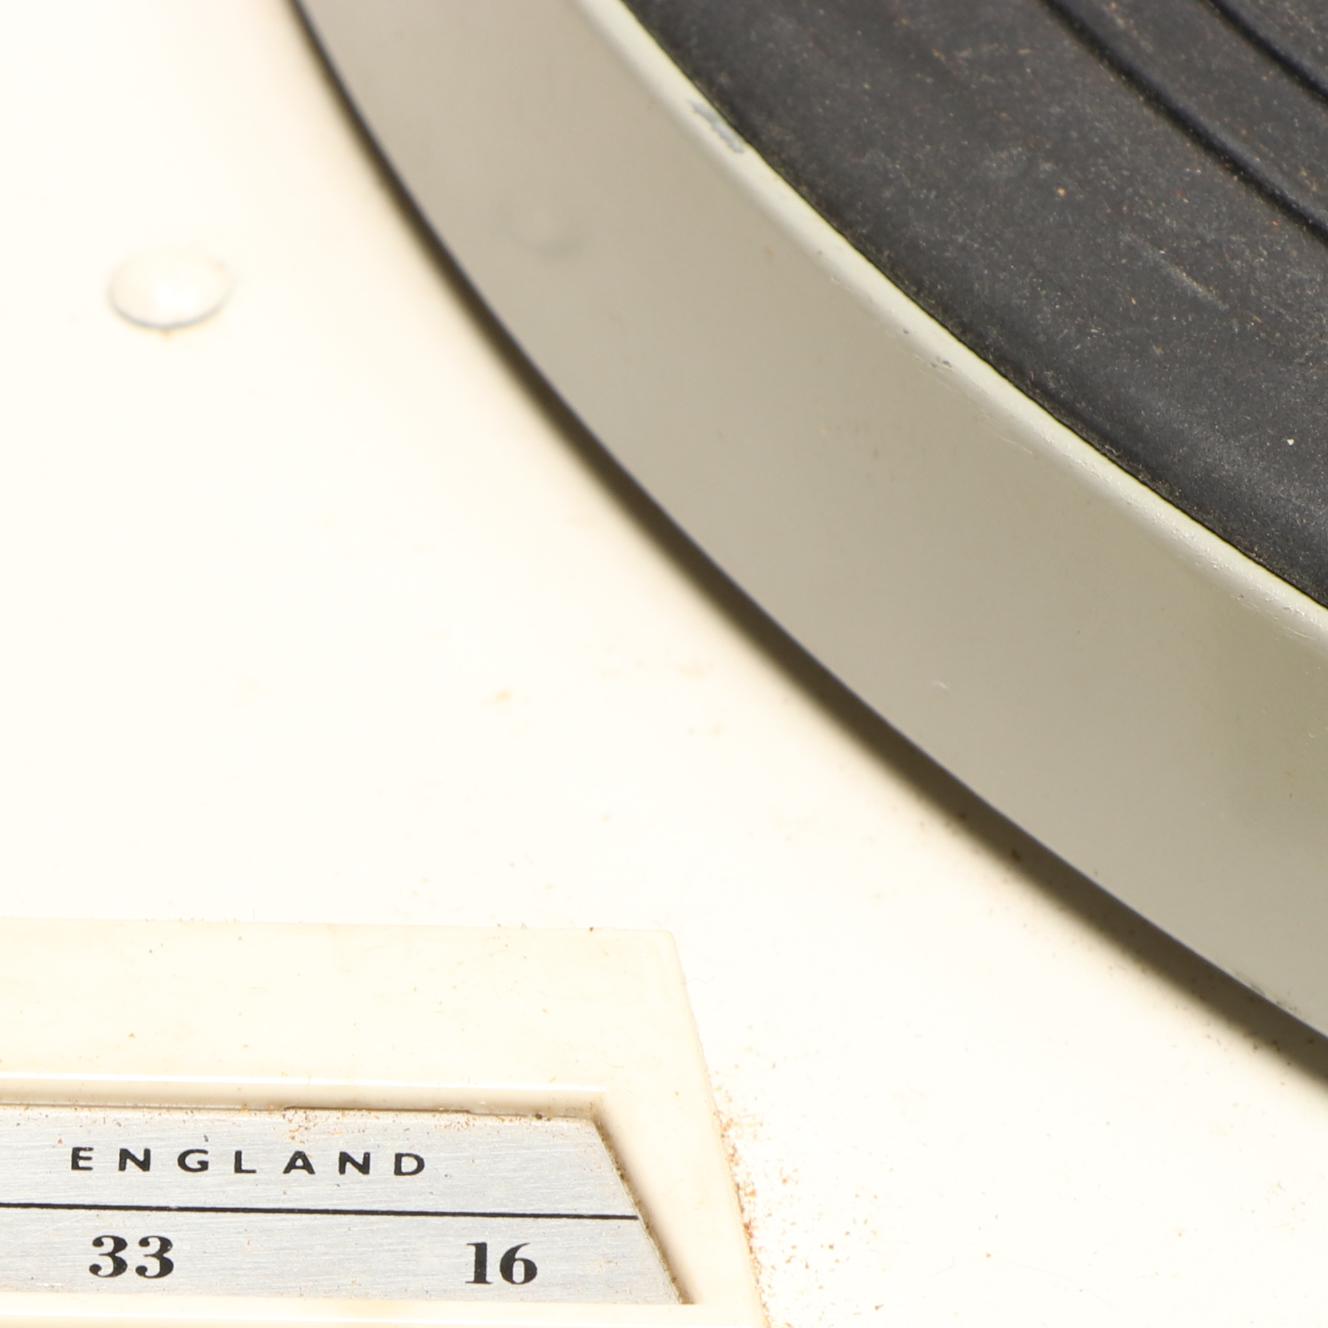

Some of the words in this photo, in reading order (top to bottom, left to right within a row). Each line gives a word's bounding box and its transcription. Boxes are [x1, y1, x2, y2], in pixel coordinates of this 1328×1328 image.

[70, 1145, 426, 1177] ENGLAND
[88, 1234, 175, 1280] 33
[466, 1240, 539, 1286] 16
